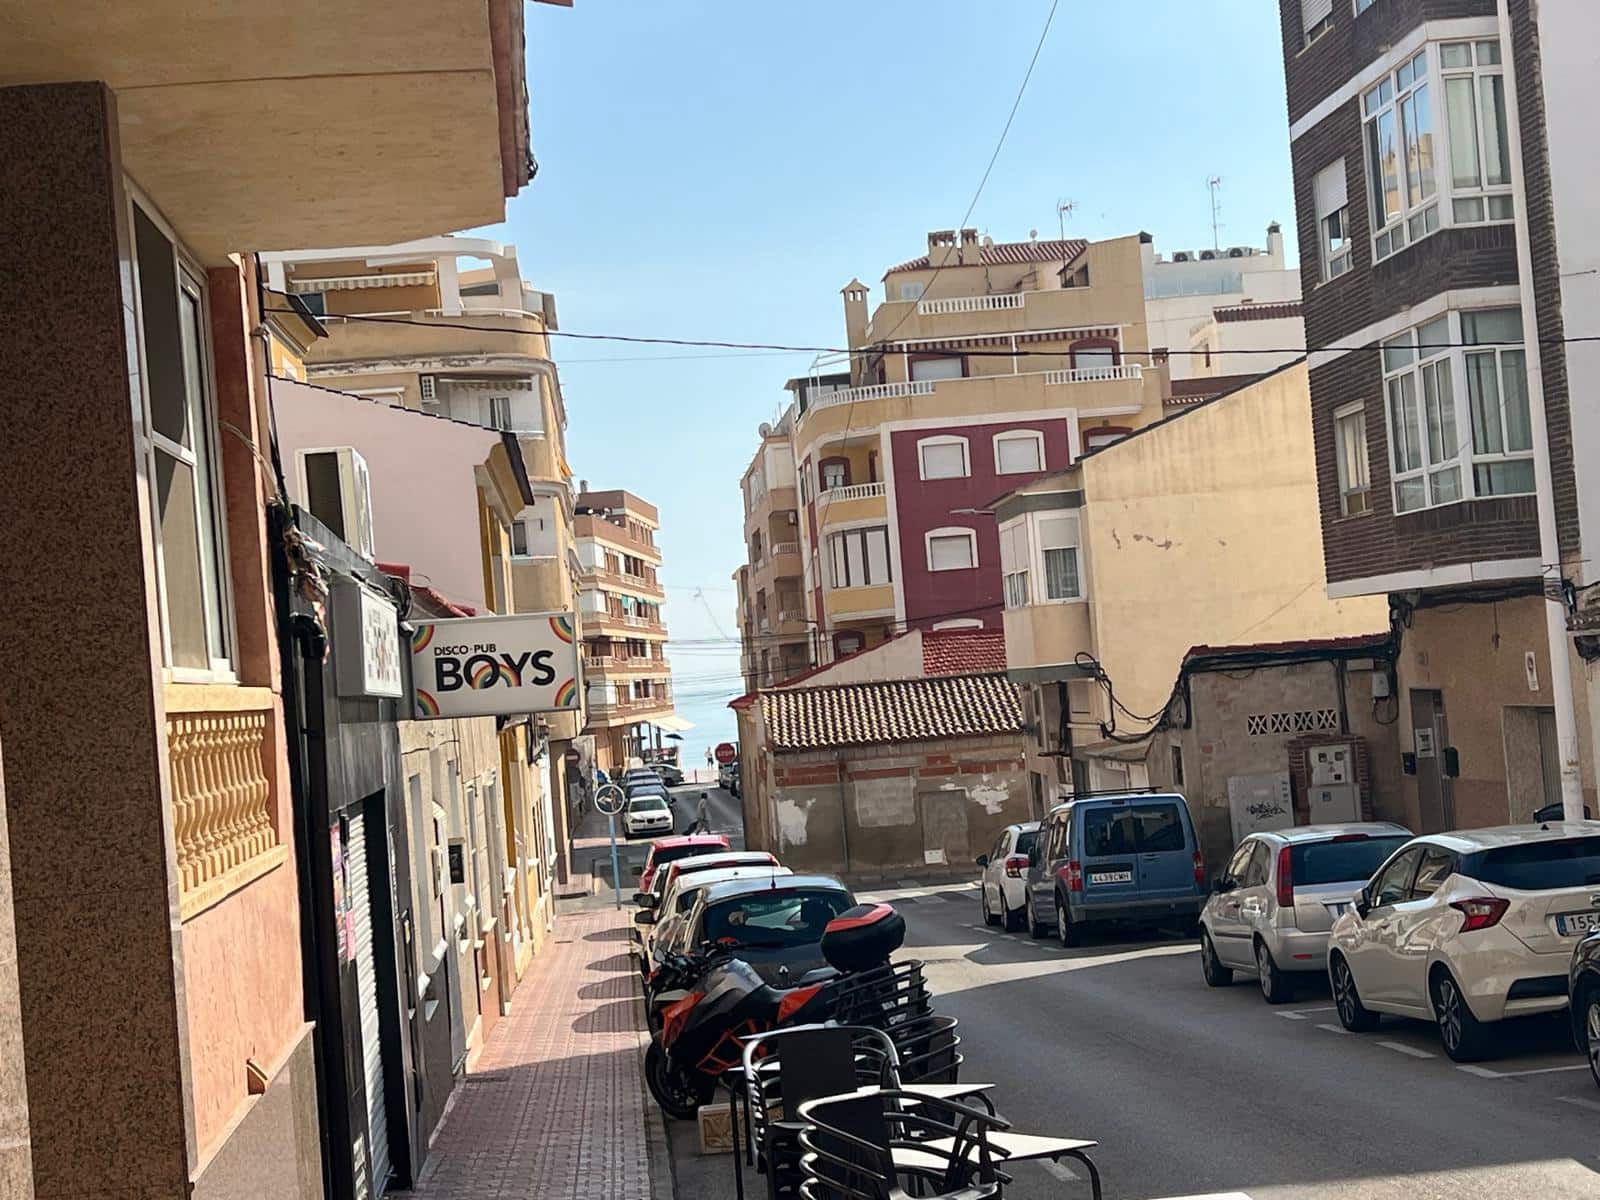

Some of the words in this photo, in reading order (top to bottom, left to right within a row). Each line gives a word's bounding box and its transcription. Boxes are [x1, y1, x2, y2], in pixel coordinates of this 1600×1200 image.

[434, 645, 469, 656] DISCO
[474, 644, 497, 653] PUB
[435, 650, 556, 692] BOYS
